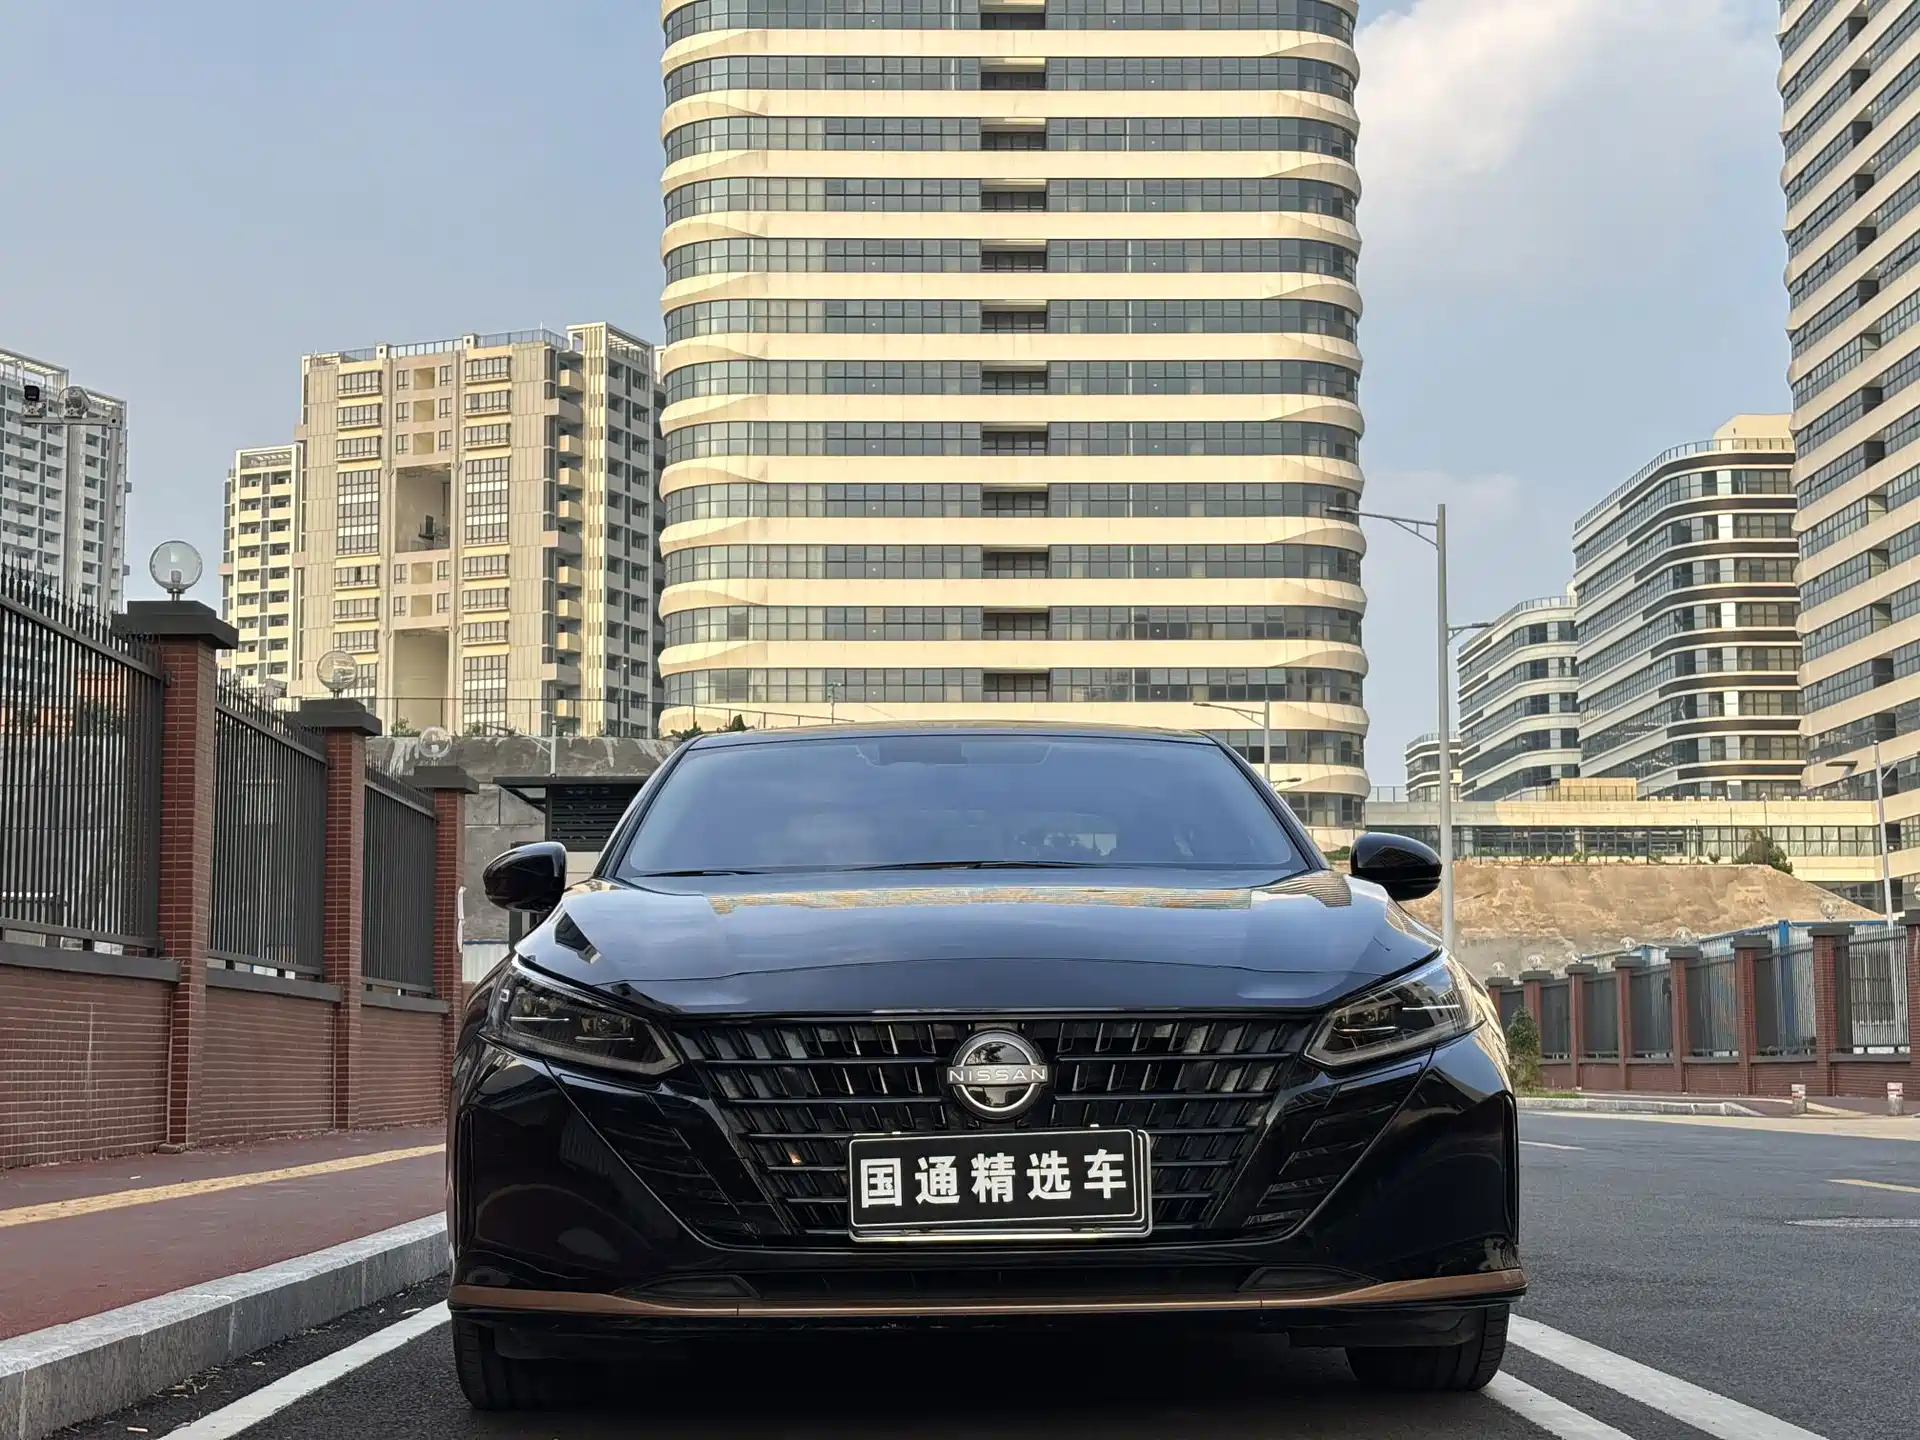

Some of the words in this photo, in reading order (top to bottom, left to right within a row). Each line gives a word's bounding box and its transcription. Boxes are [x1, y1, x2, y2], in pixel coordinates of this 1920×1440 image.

[948, 1068, 1047, 1082] NISSAN
[860, 1149, 1127, 1208] 国通精选车
